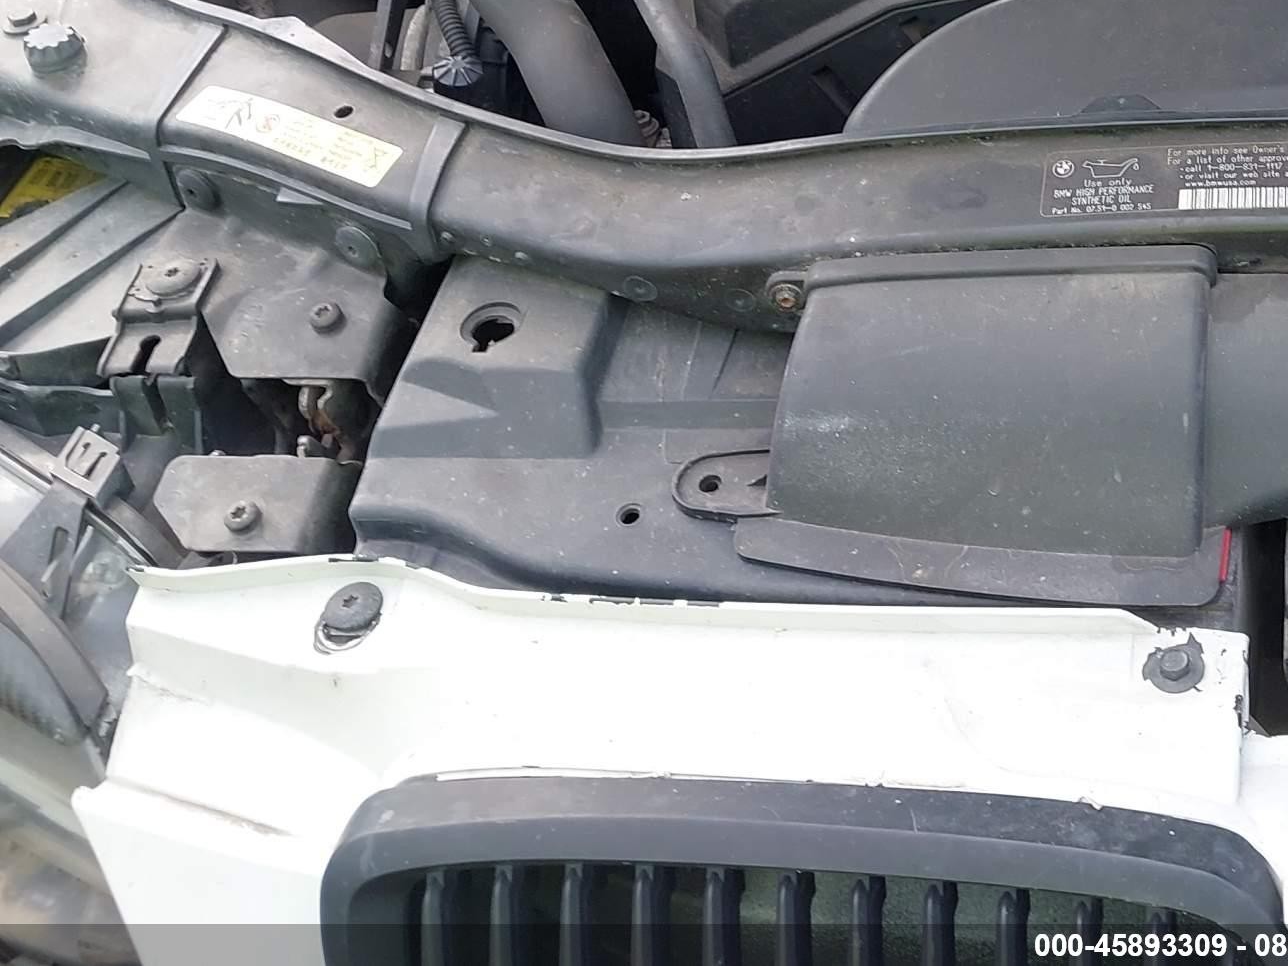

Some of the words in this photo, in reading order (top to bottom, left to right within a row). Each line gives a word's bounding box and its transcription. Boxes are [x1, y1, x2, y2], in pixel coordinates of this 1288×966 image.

[1167, 148, 1182, 156] For
[1211, 147, 1229, 155] info
[1234, 147, 1248, 155] see
[1252, 145, 1284, 154] Owner's
[1167, 157, 1182, 165] For
[1196, 155, 1212, 164] list
[1217, 155, 1226, 163] of
[1231, 154, 1254, 163] other
[1185, 164, 1202, 172] call
[1198, 171, 1219, 179] visit
[1243, 170, 1259, 178] web
[1263, 170, 1280, 178] site
[1084, 179, 1102, 187] Use
[1109, 178, 1132, 186] only
[1185, 179, 1257, 187] www.bmwusa.com
[1054, 189, 1072, 198] BMW
[1076, 188, 1095, 196] HIGH
[1098, 184, 1154, 195] PERFORMANCE
[1072, 196, 1115, 205] SYNTHETIC
[1119, 195, 1131, 203] OIL
